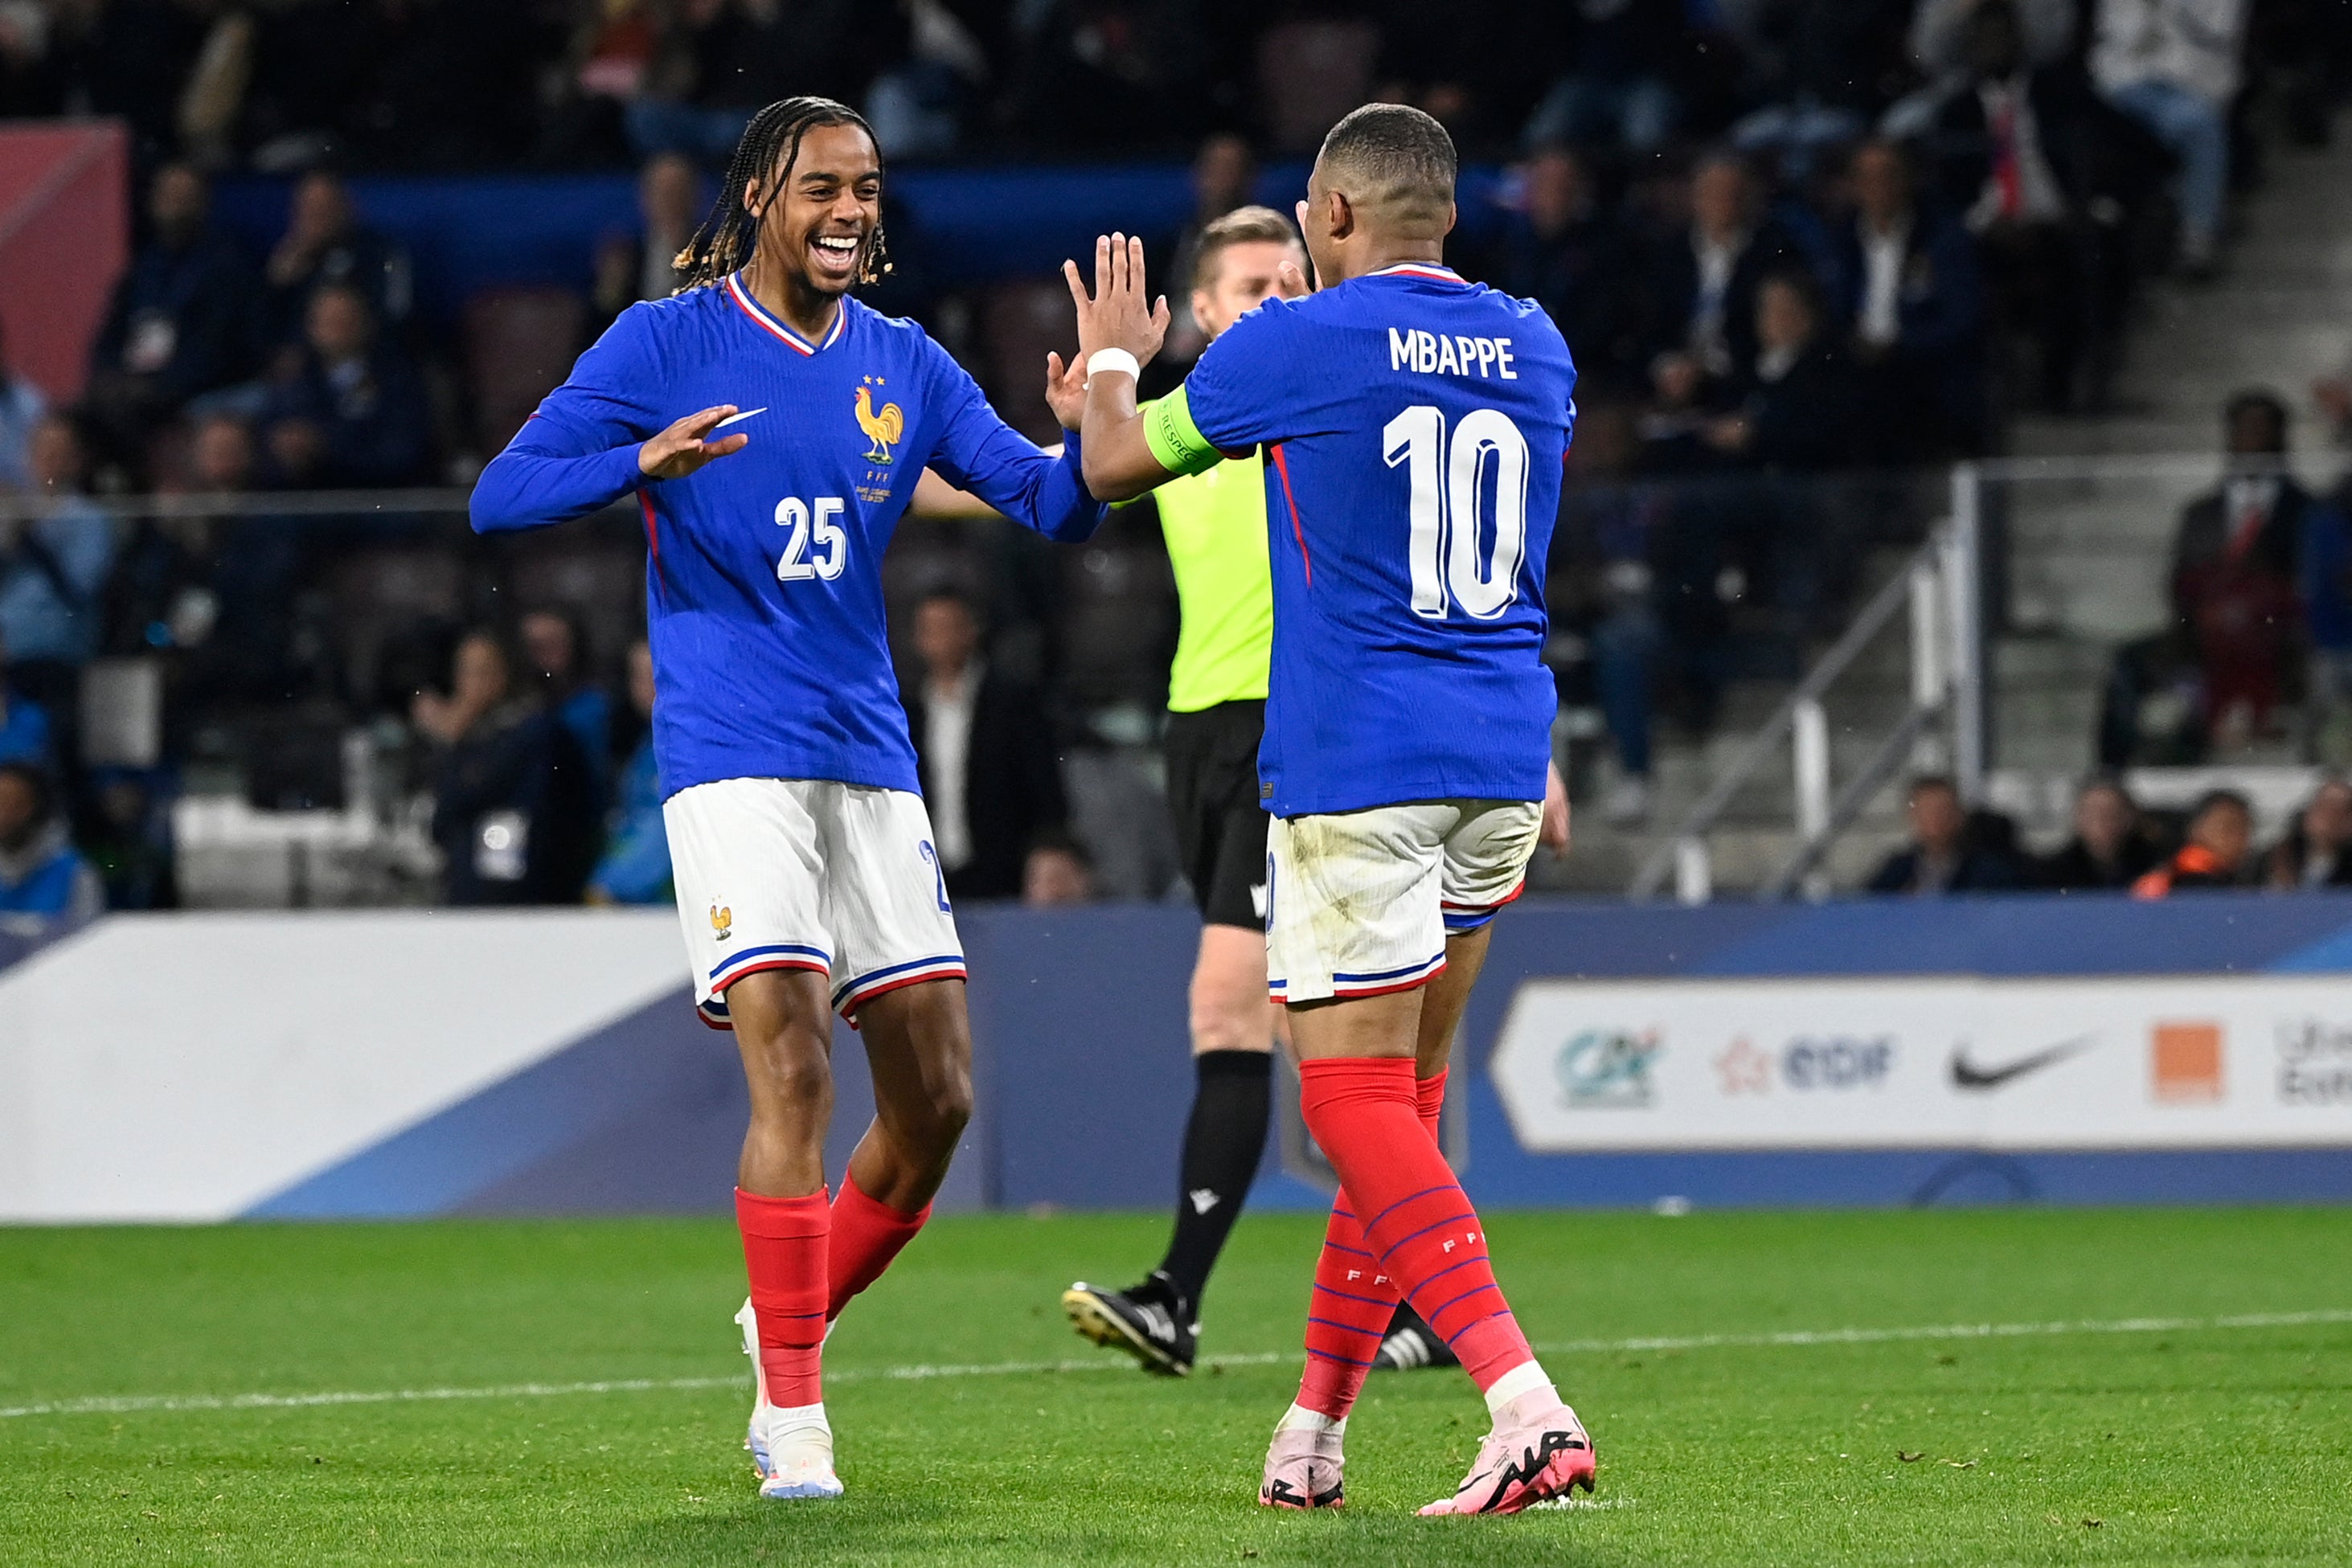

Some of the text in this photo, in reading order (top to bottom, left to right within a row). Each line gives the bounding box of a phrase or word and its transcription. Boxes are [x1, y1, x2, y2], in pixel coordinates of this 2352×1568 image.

[1388, 327, 1518, 379] MBAPPE
[1162, 415, 1202, 463] RESPECT
[1383, 405, 1530, 620] 10
[774, 497, 846, 581] 25
[1442, 1232, 1486, 1254] FF
[1346, 1269, 1397, 1289] FF
